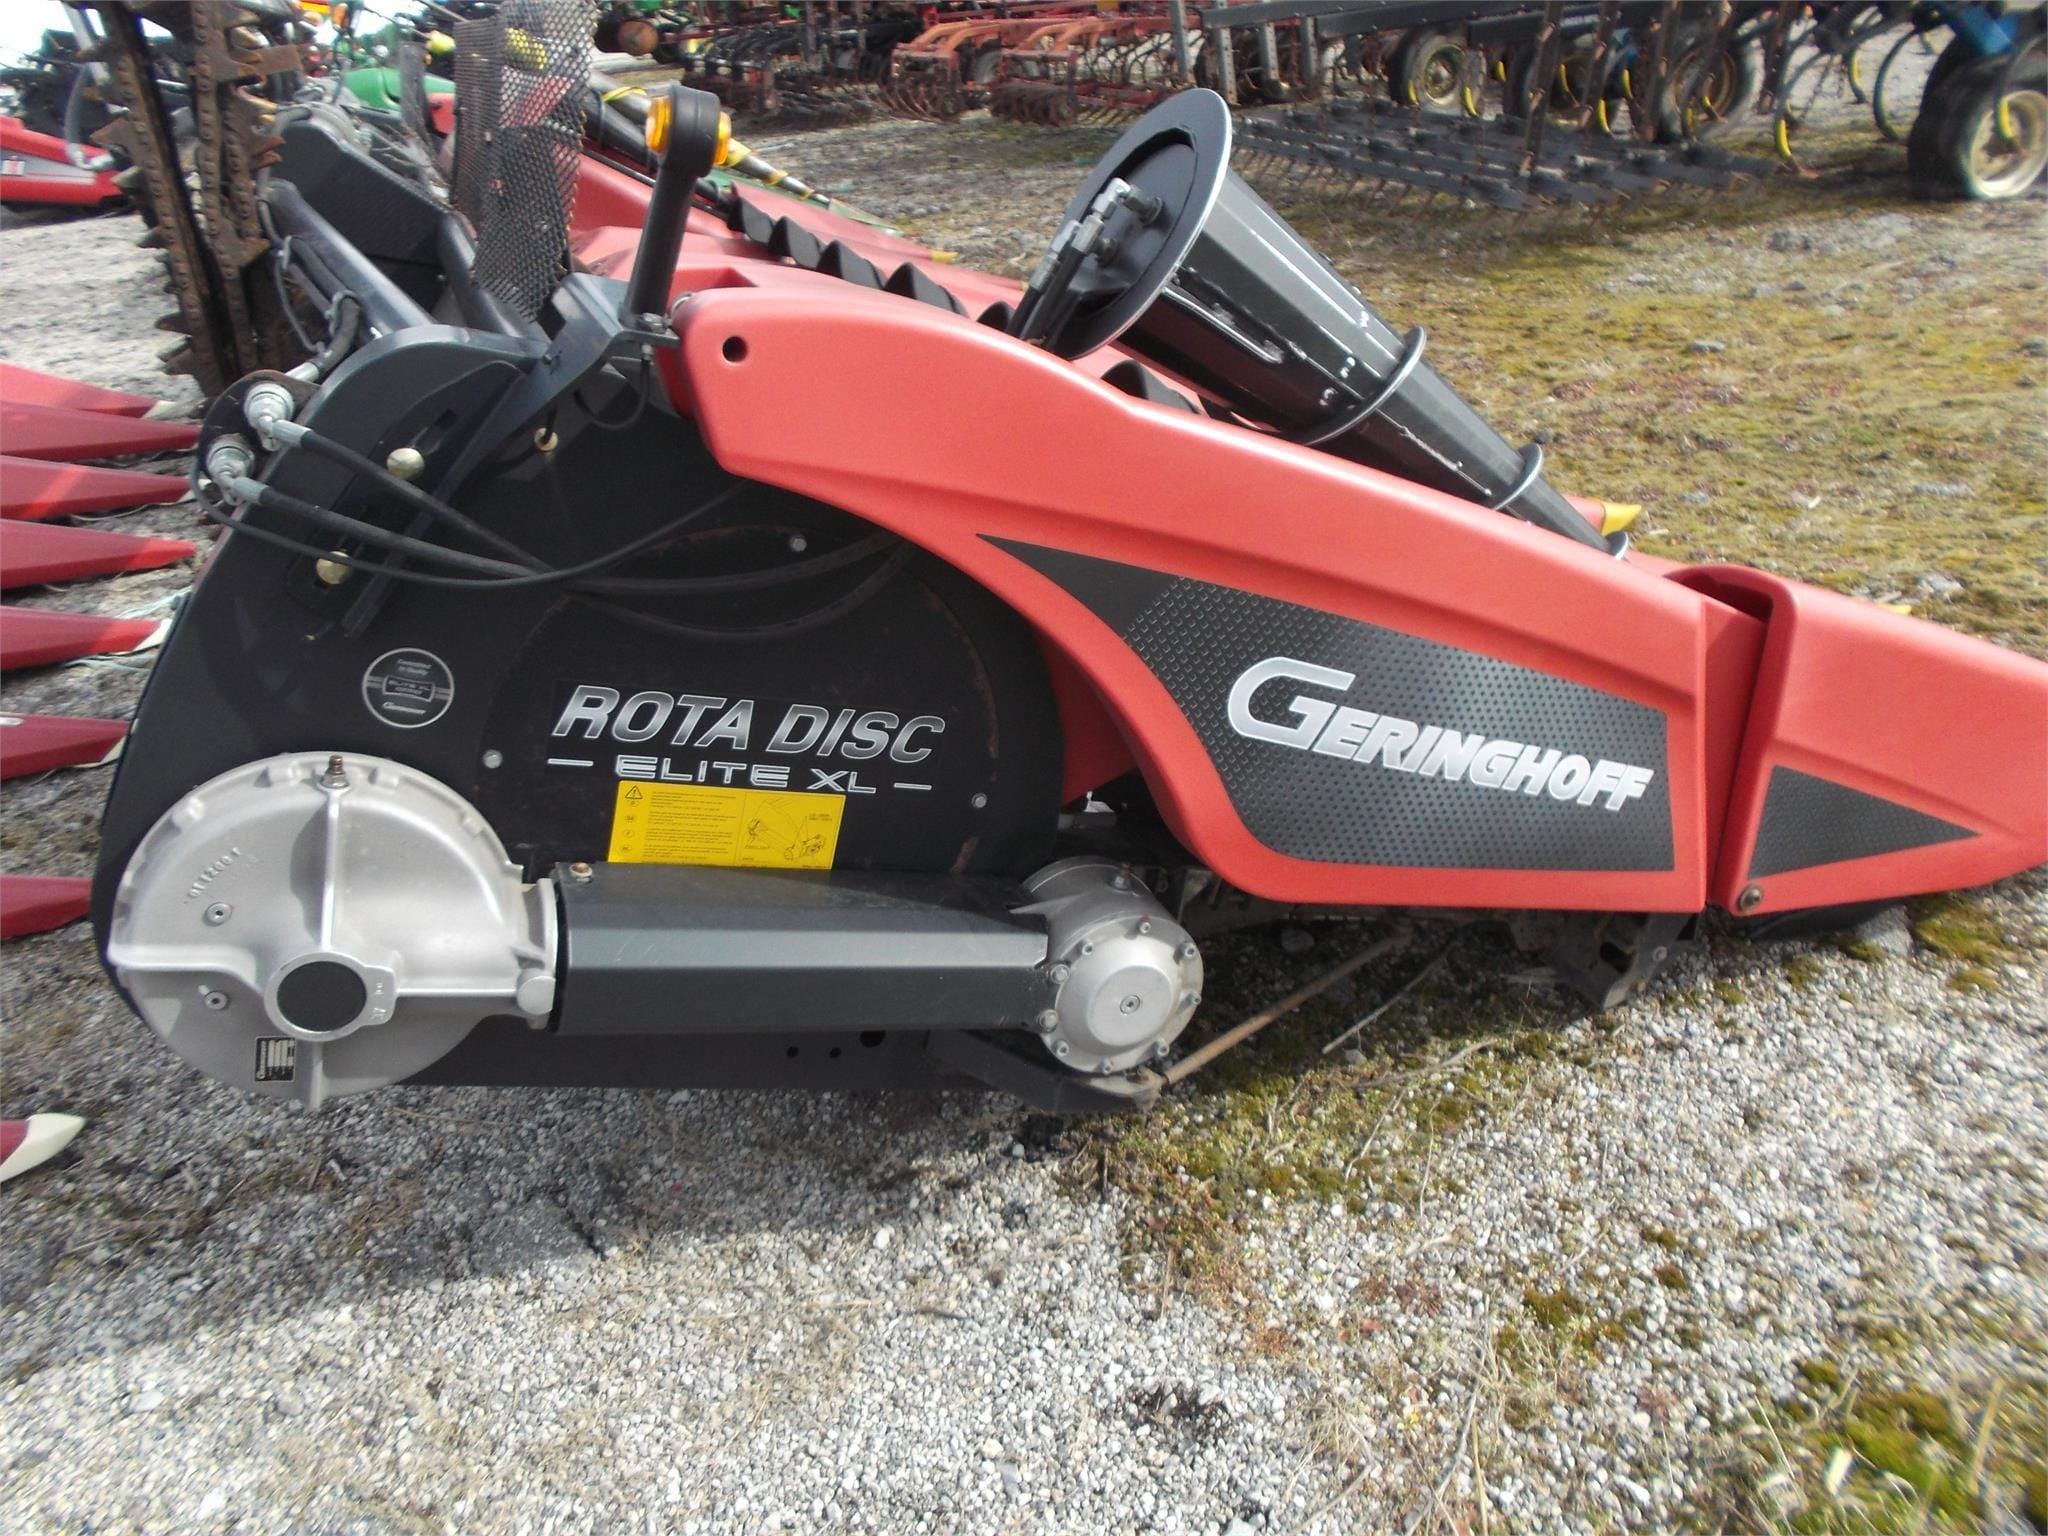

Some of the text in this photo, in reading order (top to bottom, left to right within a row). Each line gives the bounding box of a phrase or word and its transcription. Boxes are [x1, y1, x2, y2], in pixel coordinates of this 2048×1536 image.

[551, 684, 946, 764] ROTA DISC
[1227, 656, 1655, 812] GERINGHOFF
[614, 754, 877, 794] ELITE XL
